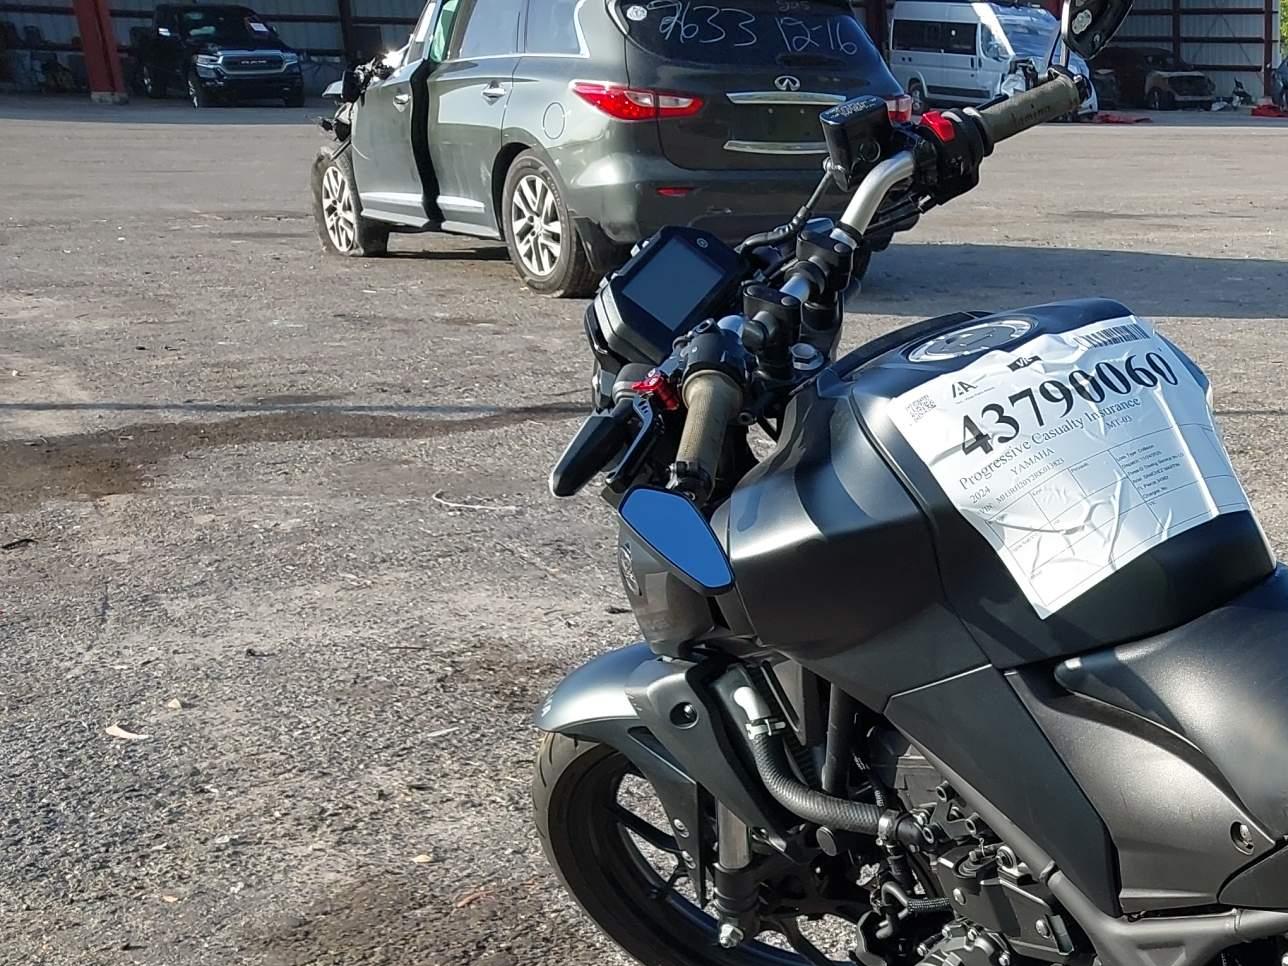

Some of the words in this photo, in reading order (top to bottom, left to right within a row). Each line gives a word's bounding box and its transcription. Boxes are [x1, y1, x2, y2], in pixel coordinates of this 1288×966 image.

[959, 441, 1032, 490] Progressive
[1031, 418, 1084, 444] Casualty
[1085, 397, 1141, 422] Insurance
[961, 352, 1178, 456] 43790060
[970, 486, 991, 504] 2024
[1010, 447, 1055, 476] YAMAHA
[1105, 414, 1133, 430] MT-03
